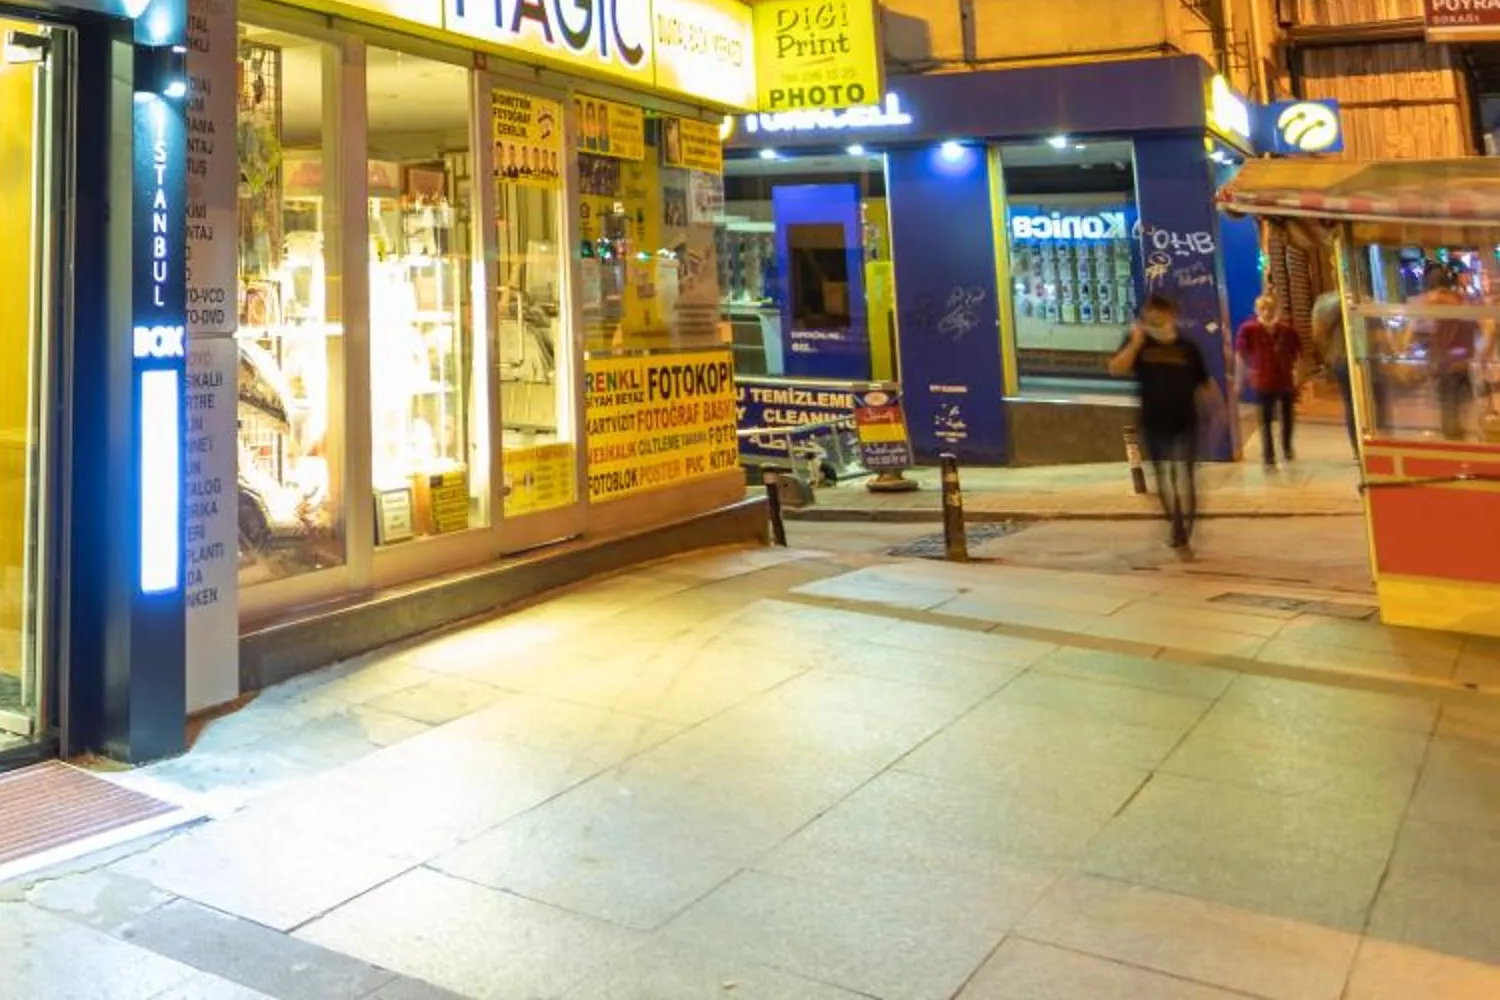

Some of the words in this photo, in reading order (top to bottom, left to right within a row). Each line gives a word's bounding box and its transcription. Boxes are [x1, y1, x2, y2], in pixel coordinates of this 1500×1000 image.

[776, 32, 850, 60] Print
[769, 83, 866, 108] PHOTO
[133, 325, 185, 358] BOX
